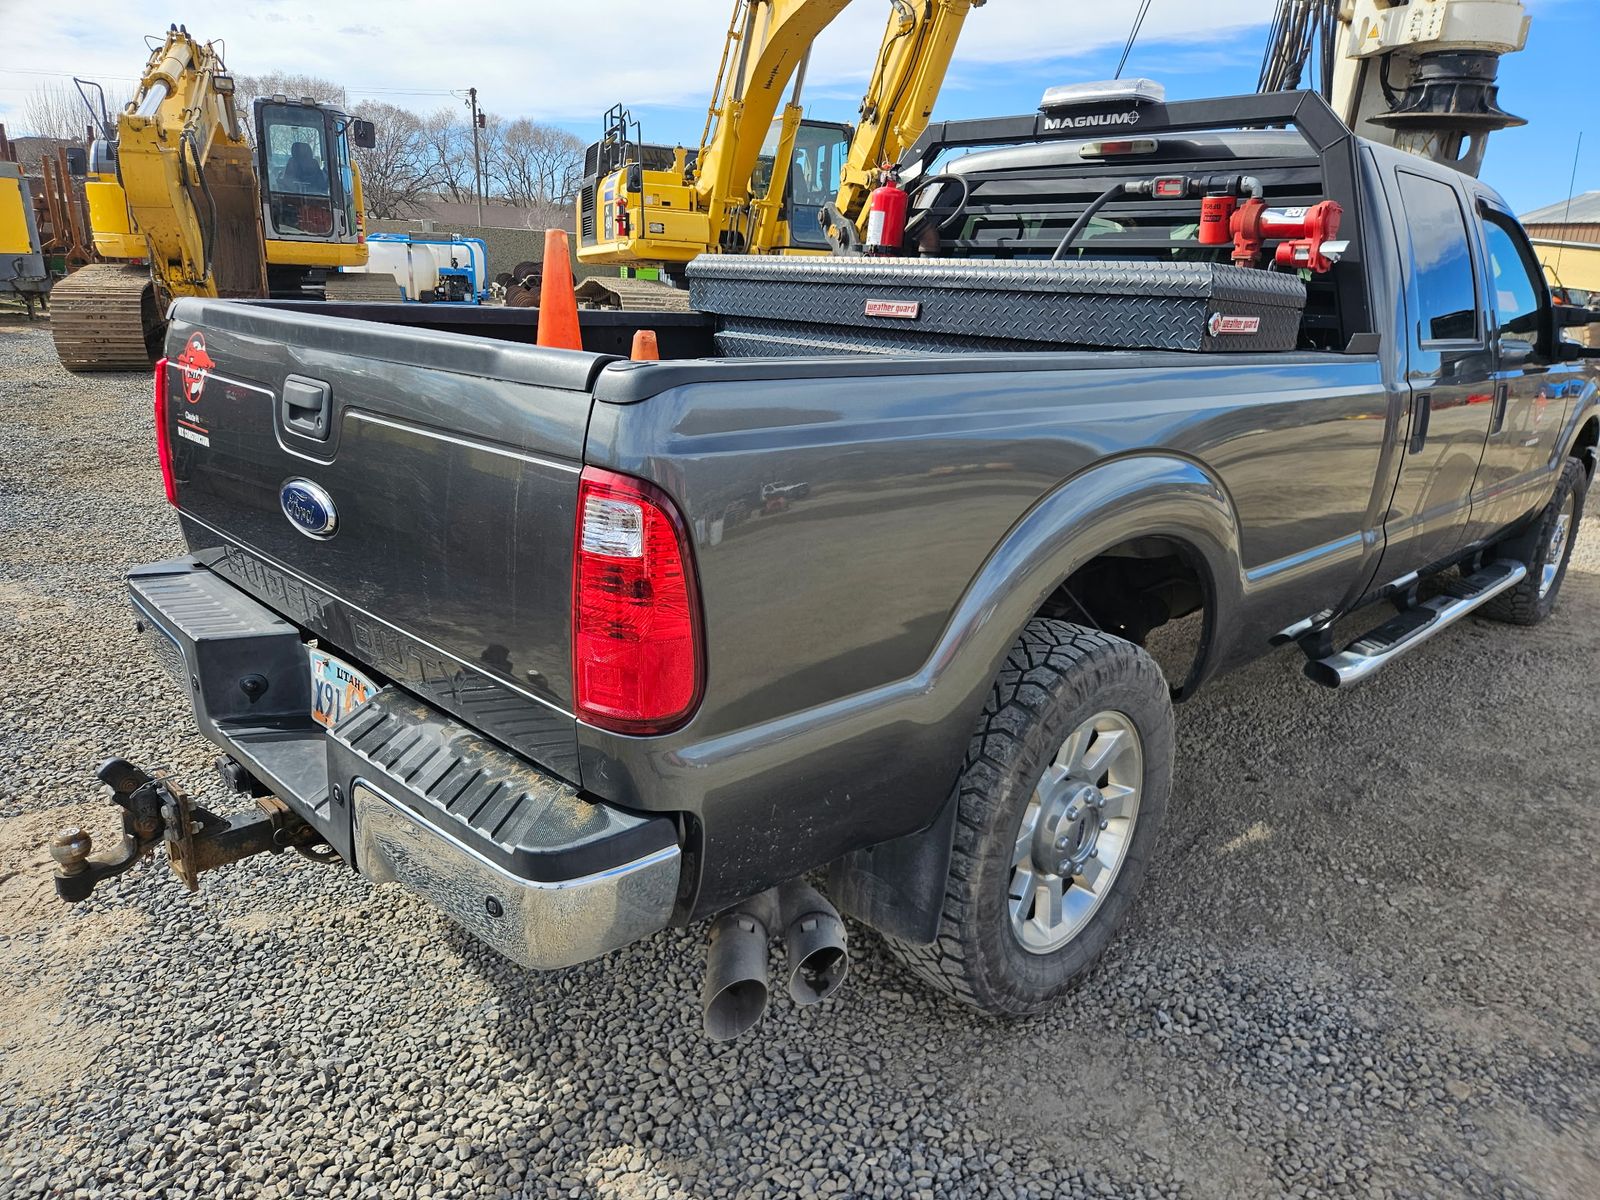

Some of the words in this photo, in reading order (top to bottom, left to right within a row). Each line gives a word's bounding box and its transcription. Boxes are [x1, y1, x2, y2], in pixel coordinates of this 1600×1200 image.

[1044, 112, 1128, 130] MAGNUM
[867, 303, 895, 312] weather
[895, 304, 916, 313] guard
[1222, 319, 1244, 329] weather
[286, 489, 315, 525] Ford
[223, 543, 329, 629] SUPER
[350, 613, 467, 705] DUTY
[336, 667, 361, 691] UTAH
